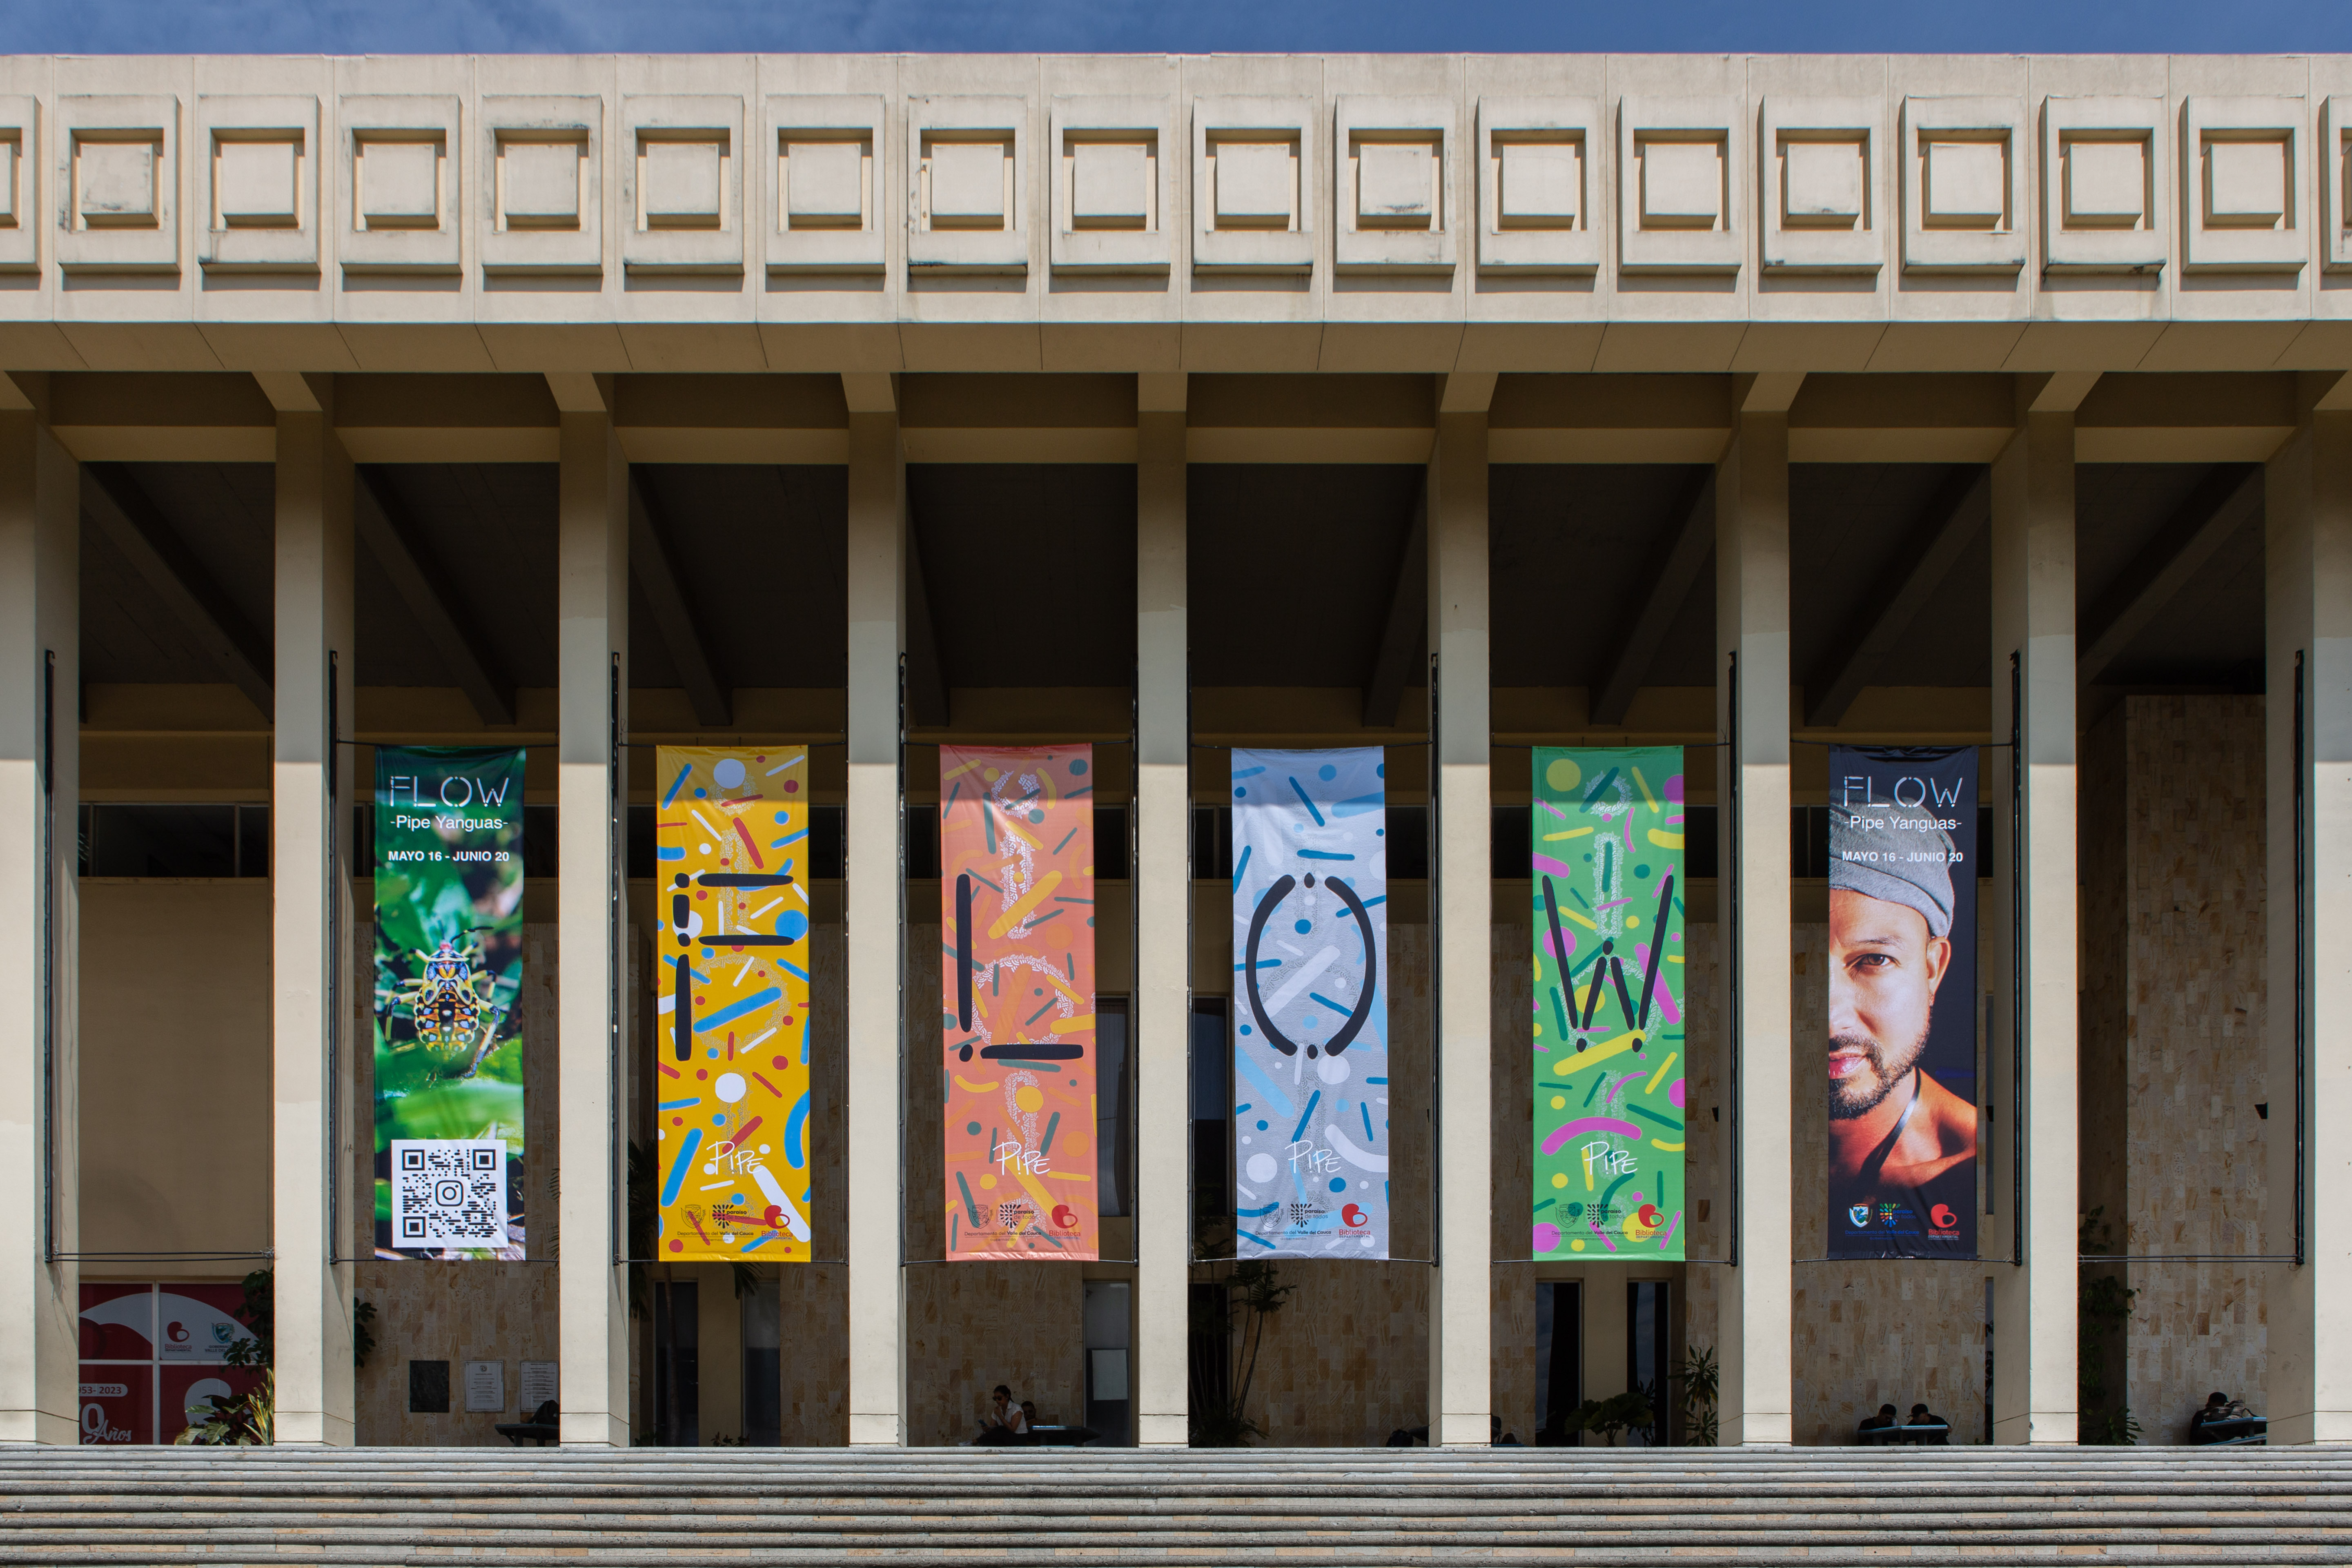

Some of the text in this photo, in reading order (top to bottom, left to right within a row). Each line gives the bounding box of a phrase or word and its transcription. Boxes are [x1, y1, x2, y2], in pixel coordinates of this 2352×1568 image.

[390, 776, 509, 807] FLOW
[1844, 776, 1963, 808] FLOW
[388, 851, 425, 862] MAYO
[428, 851, 442, 862] 16
[452, 851, 492, 862] JUNIO
[495, 851, 510, 862] 20
[1842, 851, 1879, 862] MAYO
[1882, 852, 1896, 862] 16
[1907, 852, 1945, 862] JUNIO
[1948, 852, 1964, 862] 20
